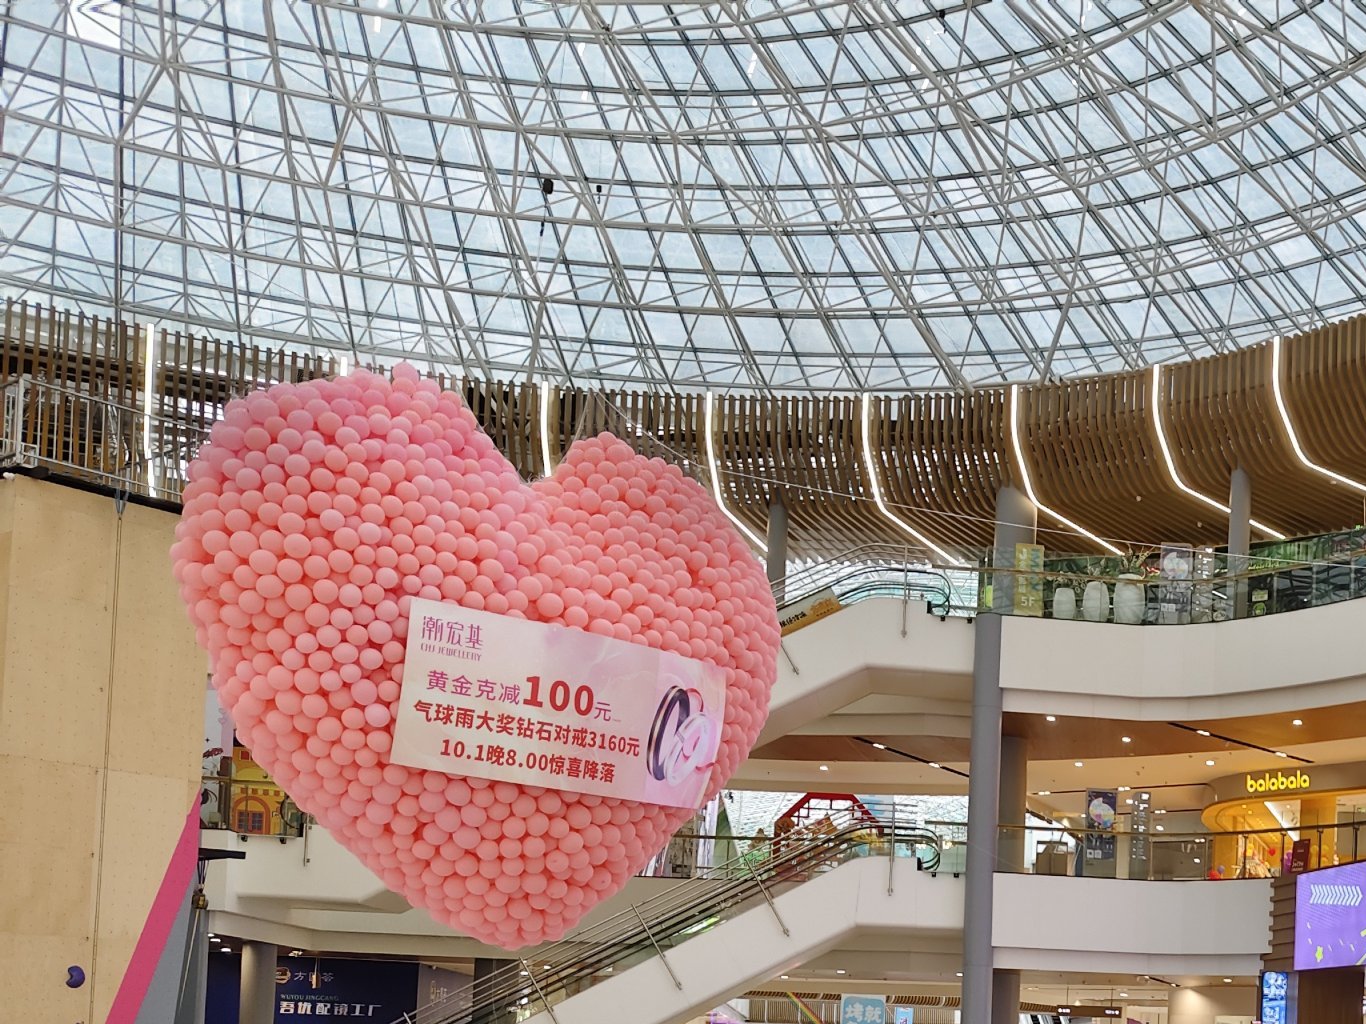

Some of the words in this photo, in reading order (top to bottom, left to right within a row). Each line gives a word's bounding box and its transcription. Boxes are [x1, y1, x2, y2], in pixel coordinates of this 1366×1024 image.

[422, 615, 483, 650] 潮宏基
[438, 646, 482, 662] JEWELLERY
[413, 700, 640, 757] 气球雨大奖钻石对戒3160元
[440, 738, 616, 784] 10.1晚8.00惊喜降落
[1246, 769, 1310, 793] balabala
